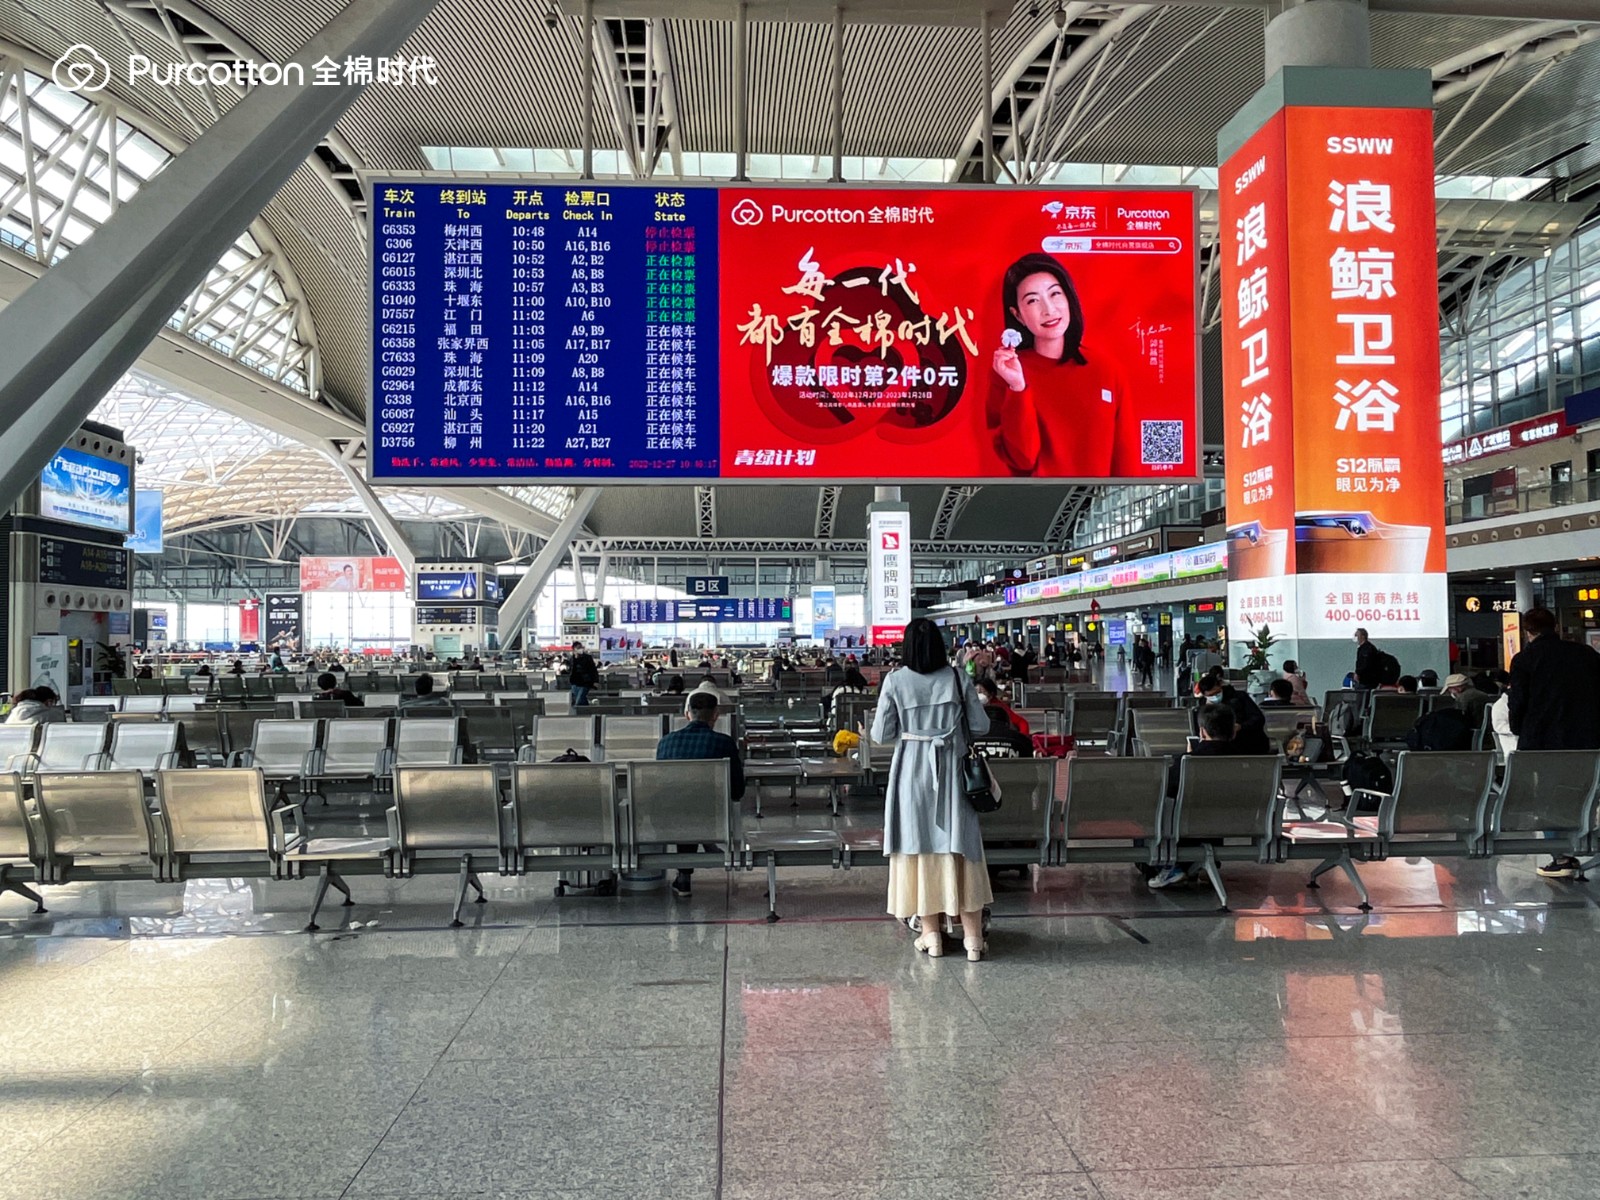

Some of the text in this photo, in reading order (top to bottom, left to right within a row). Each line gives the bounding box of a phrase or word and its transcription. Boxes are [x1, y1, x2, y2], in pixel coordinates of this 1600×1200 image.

[1327, 136, 1393, 154] SSWW
[1235, 156, 1266, 195] SSWW
[384, 189, 414, 203] 车次
[440, 190, 486, 205] 终到站
[513, 190, 543, 205] 开点
[565, 191, 609, 206] 检票口
[655, 192, 685, 207] 状态
[384, 208, 415, 217] Train
[457, 209, 470, 218] To
[506, 210, 549, 221] Departs
[563, 210, 612, 220] Check In
[655, 211, 685, 221] State
[771, 205, 934, 224] Purcotton 全棉时代
[1064, 206, 1096, 220] 京东
[1117, 207, 1170, 219] Purcotton
[383, 225, 415, 234] G6353
[444, 224, 482, 237] 梅州西
[513, 226, 544, 236] 10:48
[1126, 220, 1162, 231] 全棉时代
[578, 227, 597, 237] A14
[386, 239, 412, 248] G306
[445, 238, 482, 250] 天津西
[513, 240, 544, 250] 10:50
[382, 253, 415, 263] G6127
[444, 252, 482, 264] 湛江西
[513, 254, 544, 264] 10:52
[647, 255, 695, 267] 正在检票
[382, 267, 415, 277] G6015
[445, 267, 482, 279] 深圳北
[513, 268, 544, 278] 10:53
[647, 269, 695, 281] 正在检票
[781, 246, 920, 305] 每一代
[382, 281, 415, 291] G6333
[514, 282, 544, 292] 10:57
[647, 283, 695, 295] 正在检票
[382, 295, 415, 305] G1040
[444, 295, 482, 307] 十堰东
[514, 296, 544, 306] 11:00
[647, 297, 695, 309] 正在检票
[1327, 180, 1400, 432] 浪鲸卫浴
[383, 309, 415, 319] D7557
[513, 310, 544, 320] 11:02
[581, 311, 594, 321] A6
[648, 311, 695, 322] 正在检票
[382, 324, 415, 334] G6215
[513, 325, 544, 335] 11:03
[1235, 201, 1272, 449] 浪鲸卫浴
[646, 325, 696, 337] 正在候车
[736, 303, 979, 367] 都有全棉时代
[382, 338, 415, 348] G6358
[438, 337, 488, 350] 张家界西
[513, 339, 544, 349] 11:05
[646, 339, 696, 351] 正在候车
[382, 352, 415, 362] C7633
[513, 353, 544, 363] 11:09
[578, 354, 598, 363] A20
[646, 353, 696, 365] 正在候车
[382, 366, 415, 376] G6029
[444, 366, 482, 378] 深圳北
[514, 367, 545, 377] 11:09
[646, 367, 696, 379] 正在候车
[771, 365, 960, 388] 爆款限时第2件0元
[382, 380, 414, 390] G2964
[444, 380, 482, 392] 成都东
[514, 381, 544, 391] 11:12
[579, 382, 597, 392] A14
[646, 381, 696, 393] 正在候车
[385, 394, 411, 404] G338
[444, 394, 482, 406] 北京西
[513, 395, 544, 405] 11:15
[646, 395, 696, 407] 正在候车
[382, 409, 414, 418] G6087
[513, 409, 544, 419] 11:17
[578, 410, 598, 420] A15
[646, 409, 696, 421] 正在候车
[382, 423, 414, 433] C6927
[444, 422, 482, 434] 湛江西
[513, 424, 545, 433] 11:20
[578, 424, 597, 433] A21
[647, 423, 696, 435] 正在候车
[382, 437, 415, 447] D3756
[513, 438, 544, 448] 11:22
[647, 437, 696, 449] 正在候车
[733, 449, 817, 466] 青绿计划
[1336, 477, 1400, 493] 眼见为净
[695, 580, 720, 593] B区
[1325, 592, 1419, 605] 全国招商热线
[1325, 609, 1420, 621] 400-060-6111
